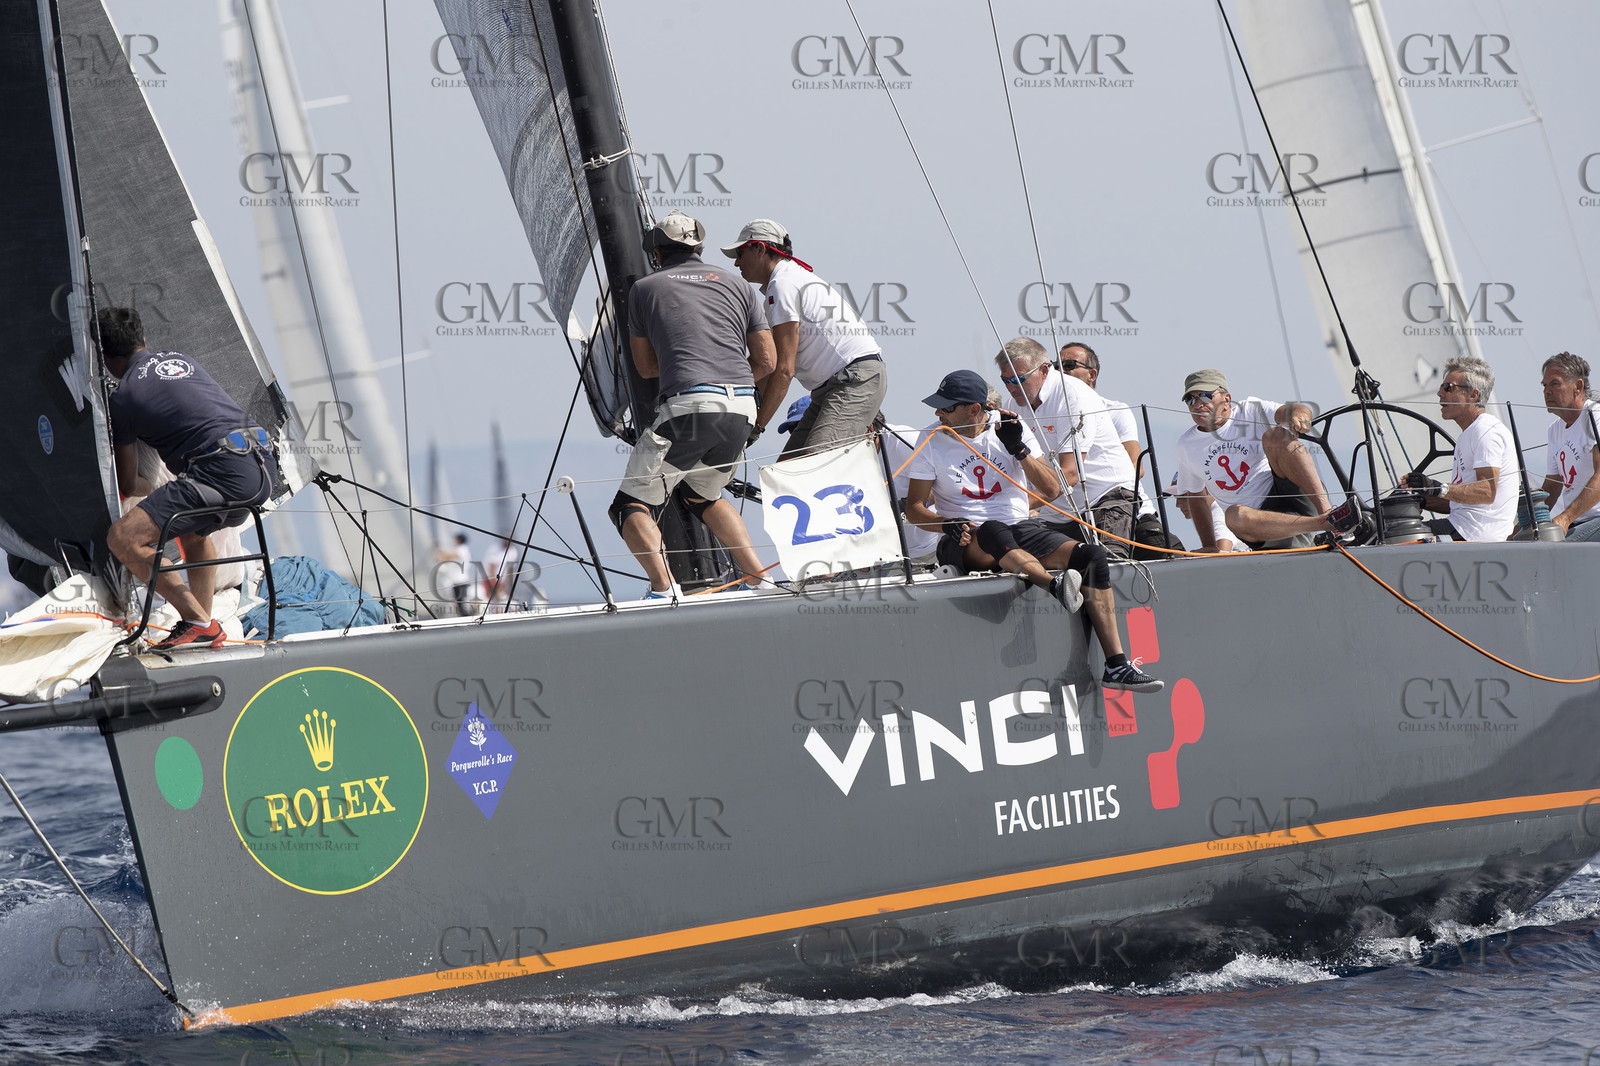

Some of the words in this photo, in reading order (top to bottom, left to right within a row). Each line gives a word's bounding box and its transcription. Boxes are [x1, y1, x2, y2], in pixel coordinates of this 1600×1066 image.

[955, 472, 963, 484] LE
[771, 484, 875, 546] 23
[451, 754, 495, 774] Porquerolle's
[496, 753, 513, 764] Race
[804, 684, 1085, 797] VINCI
[264, 775, 396, 832] ROLEX
[472, 779, 499, 796] Y.C.P.
[994, 784, 1121, 836] FACILITIES
